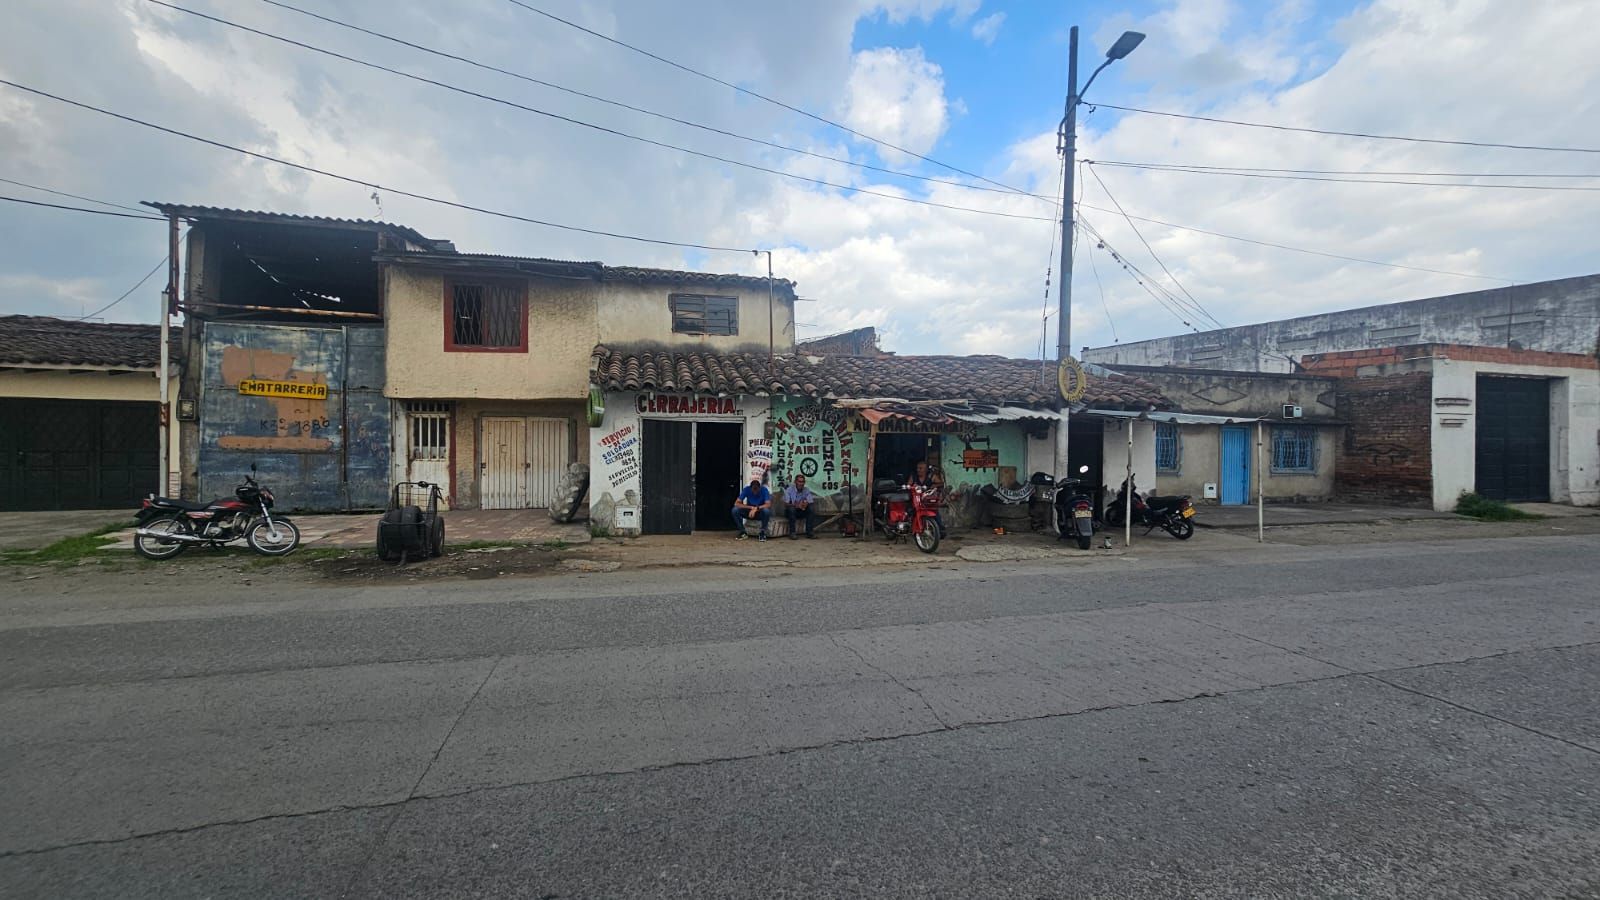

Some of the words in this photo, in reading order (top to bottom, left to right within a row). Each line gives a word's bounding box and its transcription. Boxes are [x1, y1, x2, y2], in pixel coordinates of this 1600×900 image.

[239, 381, 326, 396] CHATARRERIA
[637, 395, 735, 414] CERRAJERIA
[601, 426, 632, 446] SERVICIO
[799, 435, 812, 445] DE
[602, 437, 637, 460] SOLDADURA
[795, 446, 820, 455] AIRE
